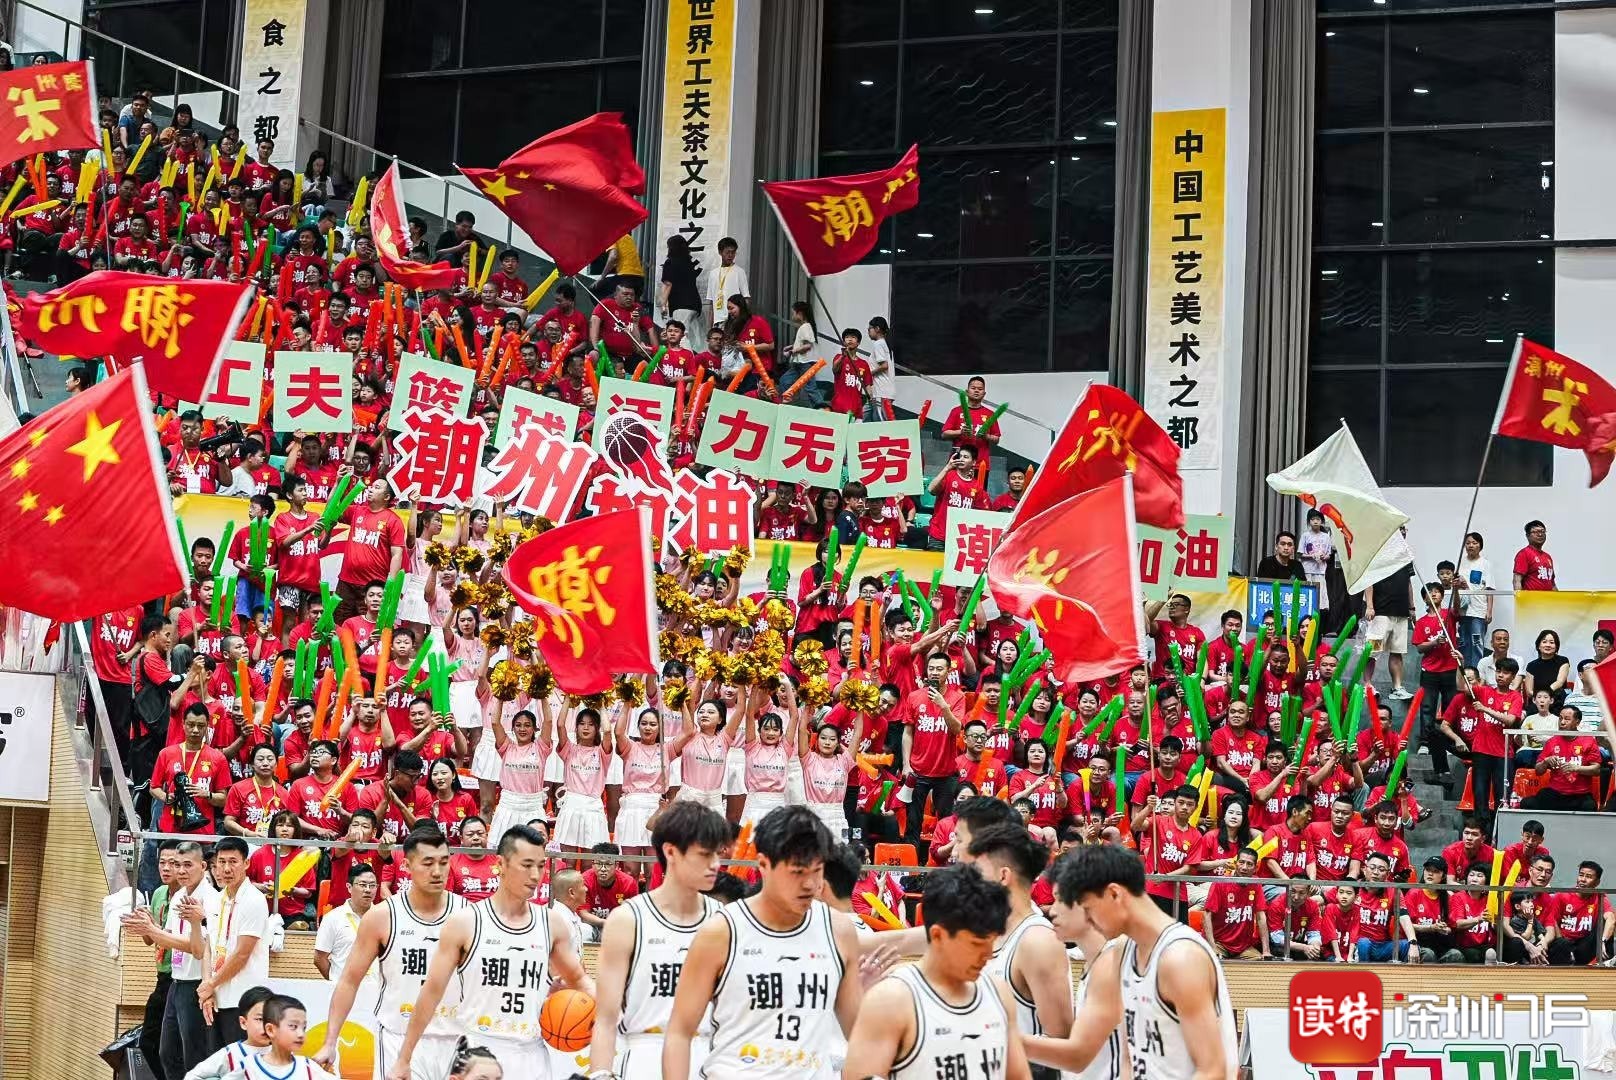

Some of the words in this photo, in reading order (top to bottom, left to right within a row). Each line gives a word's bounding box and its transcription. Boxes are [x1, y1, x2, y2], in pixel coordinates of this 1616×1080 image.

[253, 18, 287, 144] 食之都
[678, 0, 714, 278] 世界工夫茶文化之
[1167, 129, 1204, 450] 中国工艺美术之都
[949, 492, 973, 509] 潮州
[289, 538, 319, 557] 潮州
[354, 528, 380, 548] 潮州
[1259, 590, 1308, 607] 北单号
[100, 626, 133, 648] 潮州
[918, 714, 950, 735] 潮州
[351, 749, 383, 770] 潮州
[1227, 749, 1254, 766] 潮州
[1160, 842, 1189, 865] 潮州
[1279, 850, 1307, 871] 潮州
[1317, 849, 1351, 872] 潮州
[1224, 903, 1254, 925] 潮州
[1560, 914, 1593, 932] 潮州
[481, 957, 544, 991] 潮州
[651, 962, 684, 997] 潮
[747, 972, 829, 1010] 潮州
[501, 992, 525, 1014] 35
[775, 1013, 801, 1042] 13
